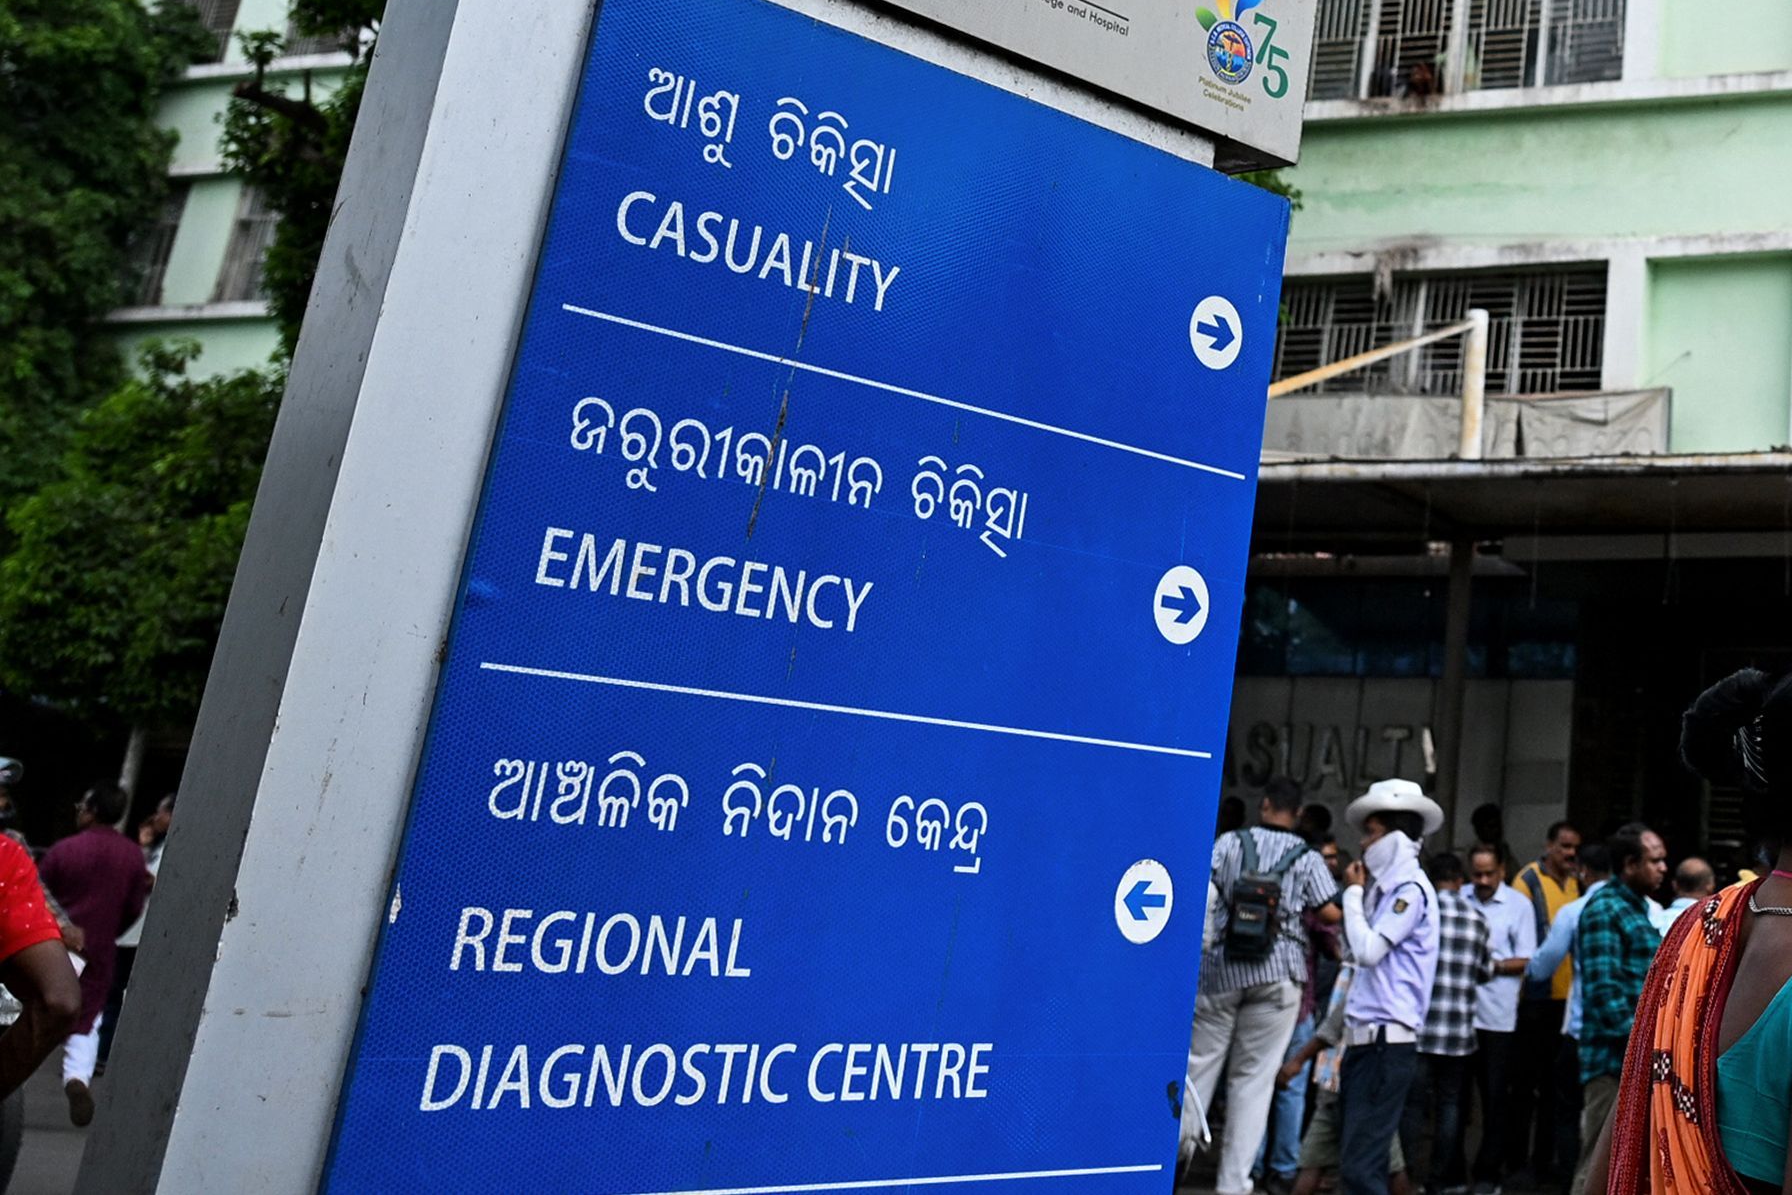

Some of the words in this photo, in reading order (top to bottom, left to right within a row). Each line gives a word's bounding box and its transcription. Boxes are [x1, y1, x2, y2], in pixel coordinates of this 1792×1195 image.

[1067, 2, 1087, 19] and
[1089, 10, 1129, 37] Hospital
[1253, 12, 1290, 99] 75
[644, 67, 740, 168] ଆଶୁ
[769, 97, 896, 210] ଚିକିତ୍ସା
[616, 190, 900, 312] CASUALITY
[911, 455, 1028, 558] ଚିକିତ୍ସା
[535, 527, 874, 632] EMERGENCY
[722, 762, 858, 844] ନିଦାନ
[886, 795, 988, 874] କେନ୍ଦ୍ର
[449, 906, 751, 977] REGIONAL
[419, 1043, 797, 1111] DIAGNOSTIC
[807, 1042, 993, 1102] CENTRE
